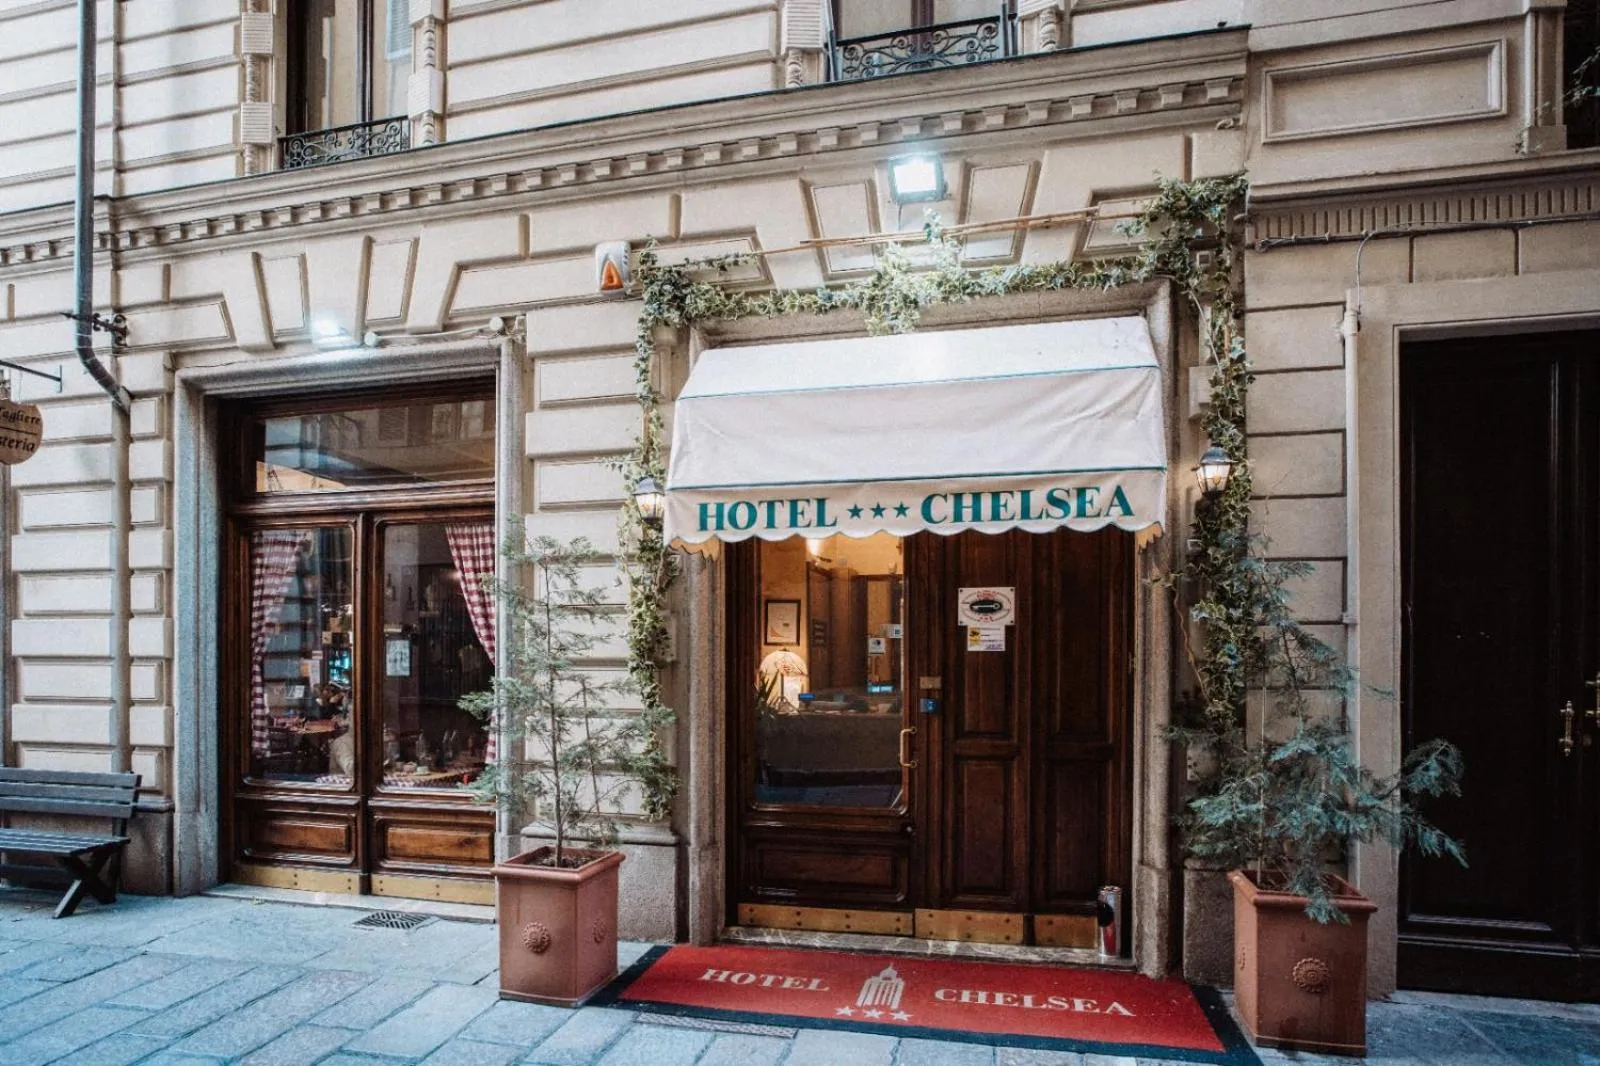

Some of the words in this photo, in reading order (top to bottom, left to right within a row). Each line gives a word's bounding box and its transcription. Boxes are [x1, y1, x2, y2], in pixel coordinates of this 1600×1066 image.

[697, 497, 838, 532] HOTEL
[921, 484, 1135, 524] CHELSEA
[698, 968, 830, 992] HOTEL
[934, 988, 1137, 1017] CHELSEA
